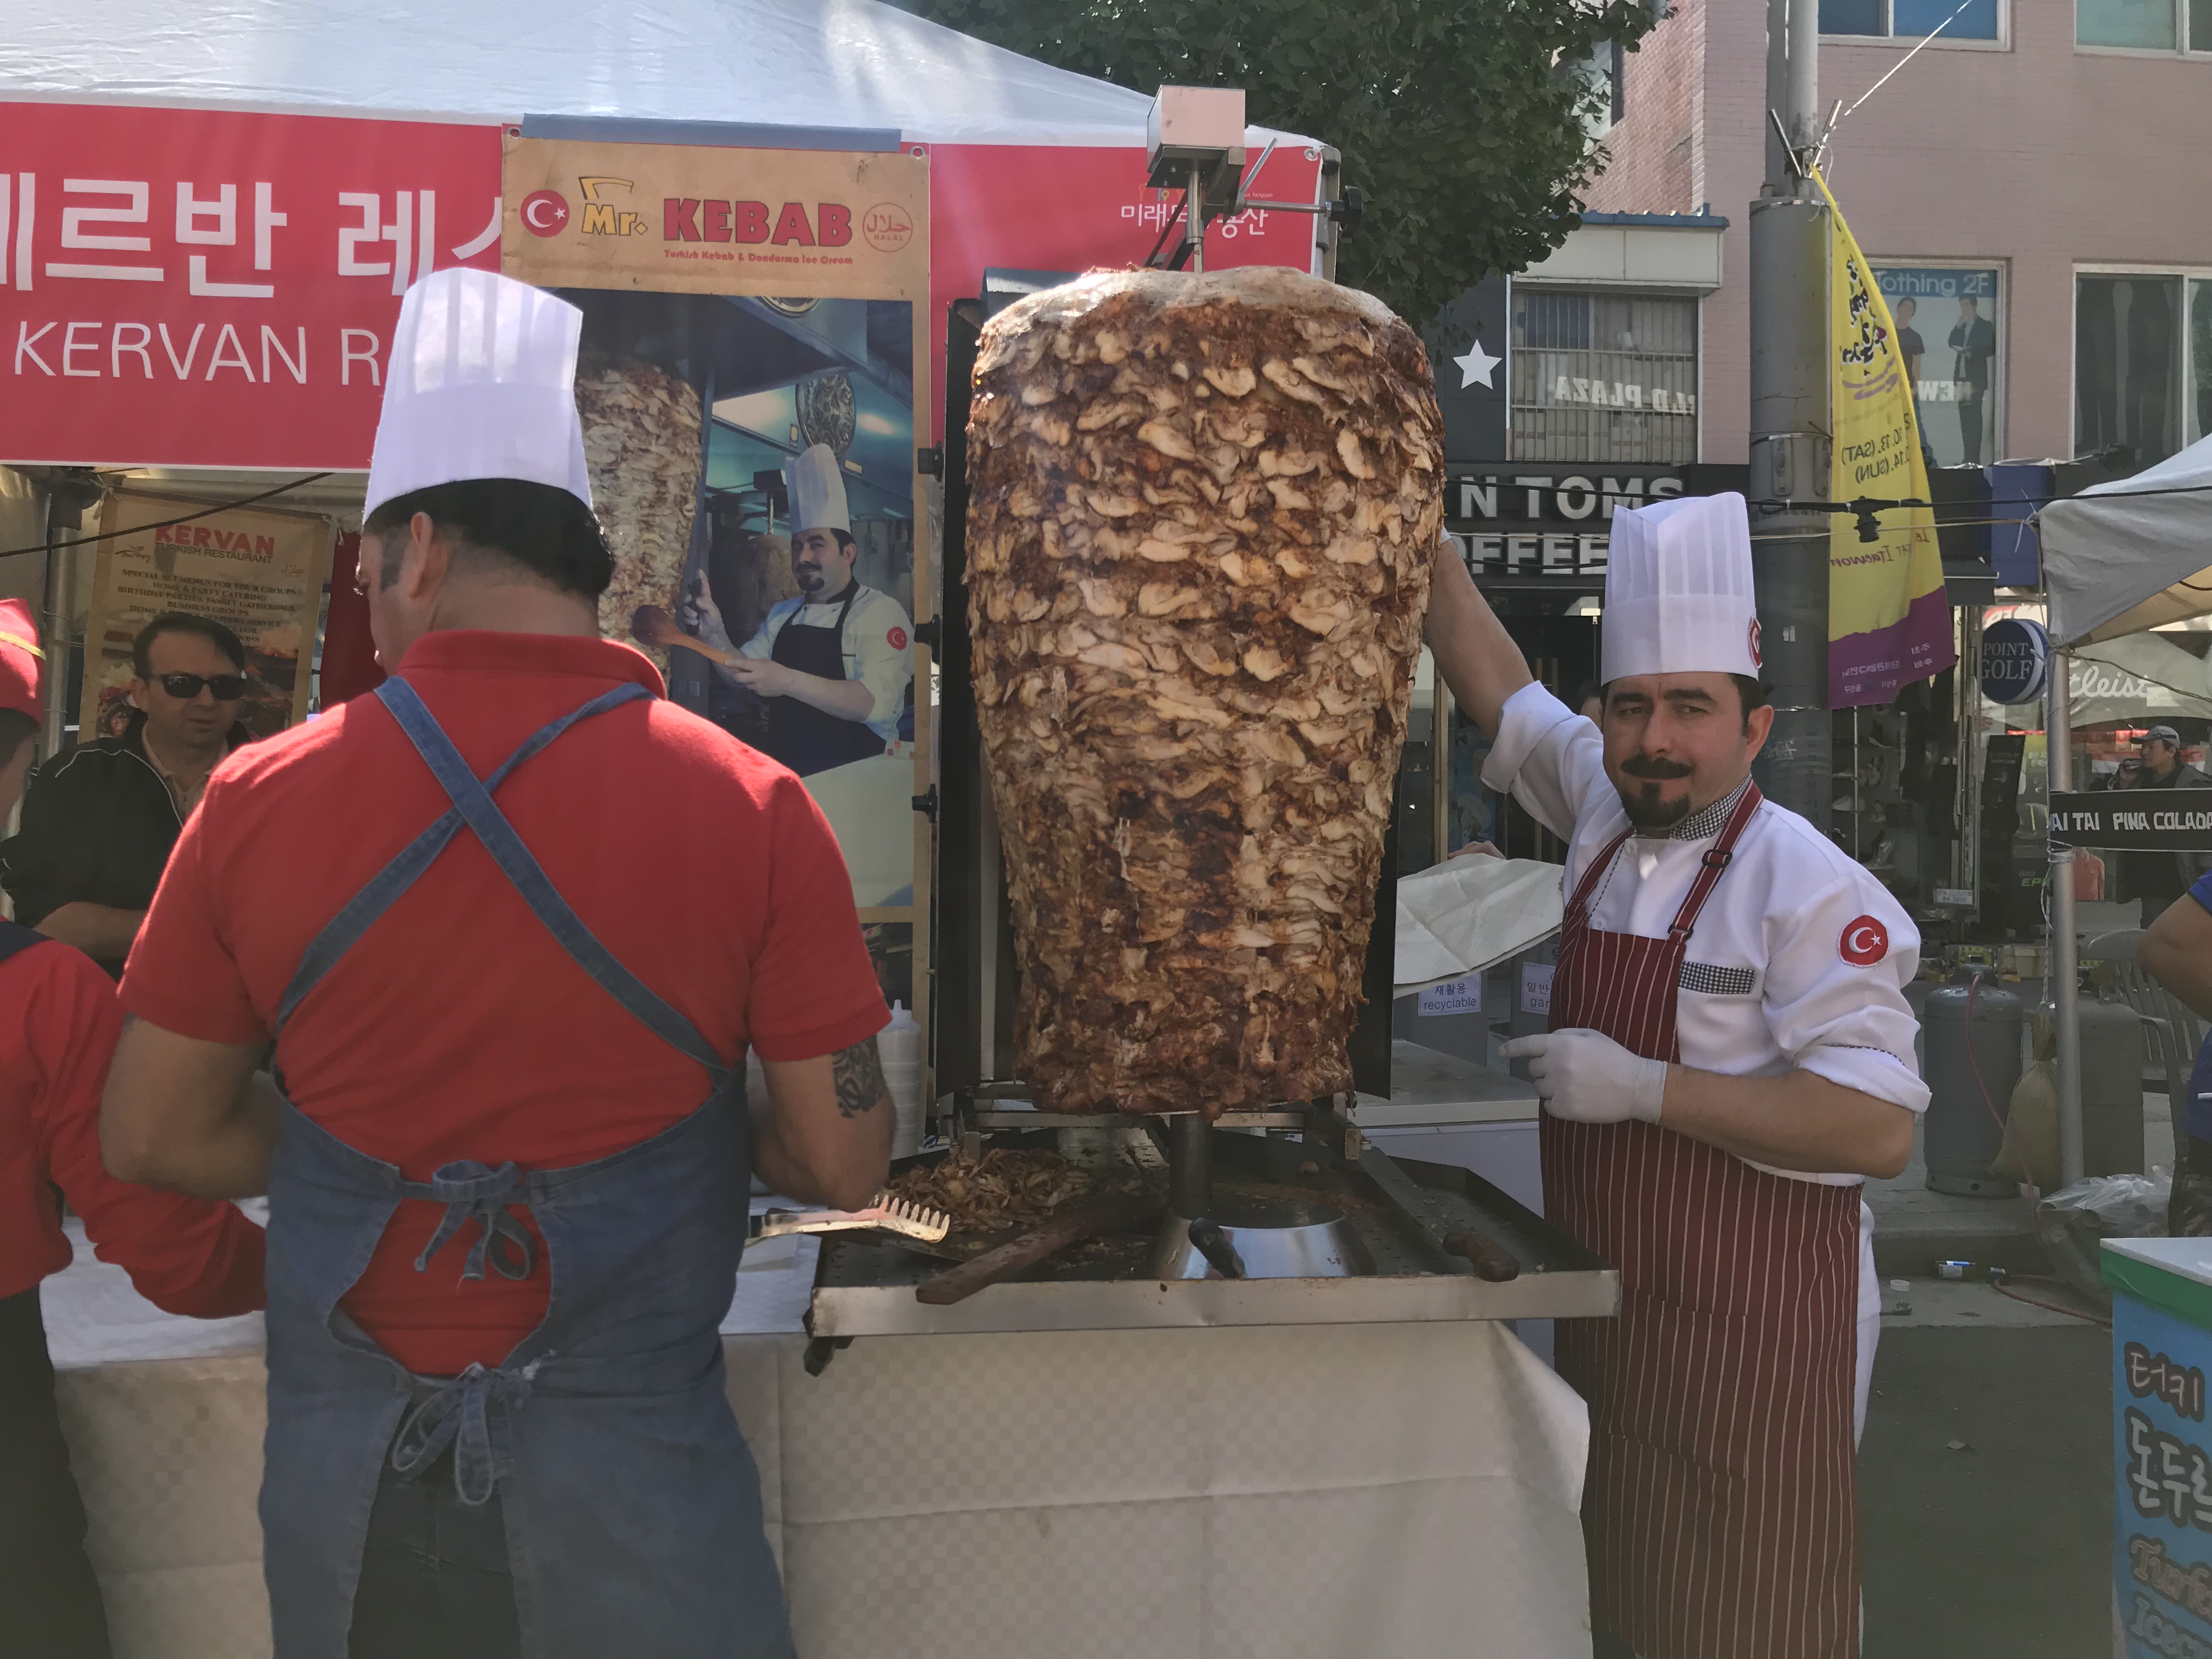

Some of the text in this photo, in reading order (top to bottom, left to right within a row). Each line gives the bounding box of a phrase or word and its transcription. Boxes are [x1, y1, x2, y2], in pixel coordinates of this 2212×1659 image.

[581, 198, 853, 247] Mr. KEBAB
[867, 213, 911, 233] حلال
[664, 250, 699, 259] Turkish
[702, 251, 734, 260] Kebab
[738, 252, 744, 261] &
[748, 253, 799, 263] Dondurma
[1963, 272, 1989, 294] 2F
[15, 321, 307, 385] KERVAN
[155, 524, 275, 556] KERVAN
[155, 542, 273, 564] TURKISH RESTAURANT
[1451, 532, 1610, 575] FFEE
[117, 586, 163, 597] BIRTHDAY
[122, 569, 159, 579] SPECIAL
[180, 577, 212, 586] MENUS
[213, 580, 232, 589] FOR
[261, 586, 296, 595] GROUPS
[153, 582, 179, 591] HOME
[192, 586, 220, 596] PARTY
[222, 590, 267, 601] CATERING
[167, 601, 211, 612] BUSINESS
[212, 606, 250, 616] GROUPS
[1983, 642, 2029, 656] POINT
[1981, 658, 2033, 680] GOLF
[2049, 812, 2068, 832] AI
[2072, 812, 2100, 831] TAI
[2113, 812, 2151, 831] PINA
[1435, 983, 1466, 996] 재활용
[1527, 981, 1550, 995] 일반
[1424, 996, 1476, 1012] recyclable
[2130, 1351, 2199, 1412] 터키
[2130, 1417, 2212, 1523] 돈두르
